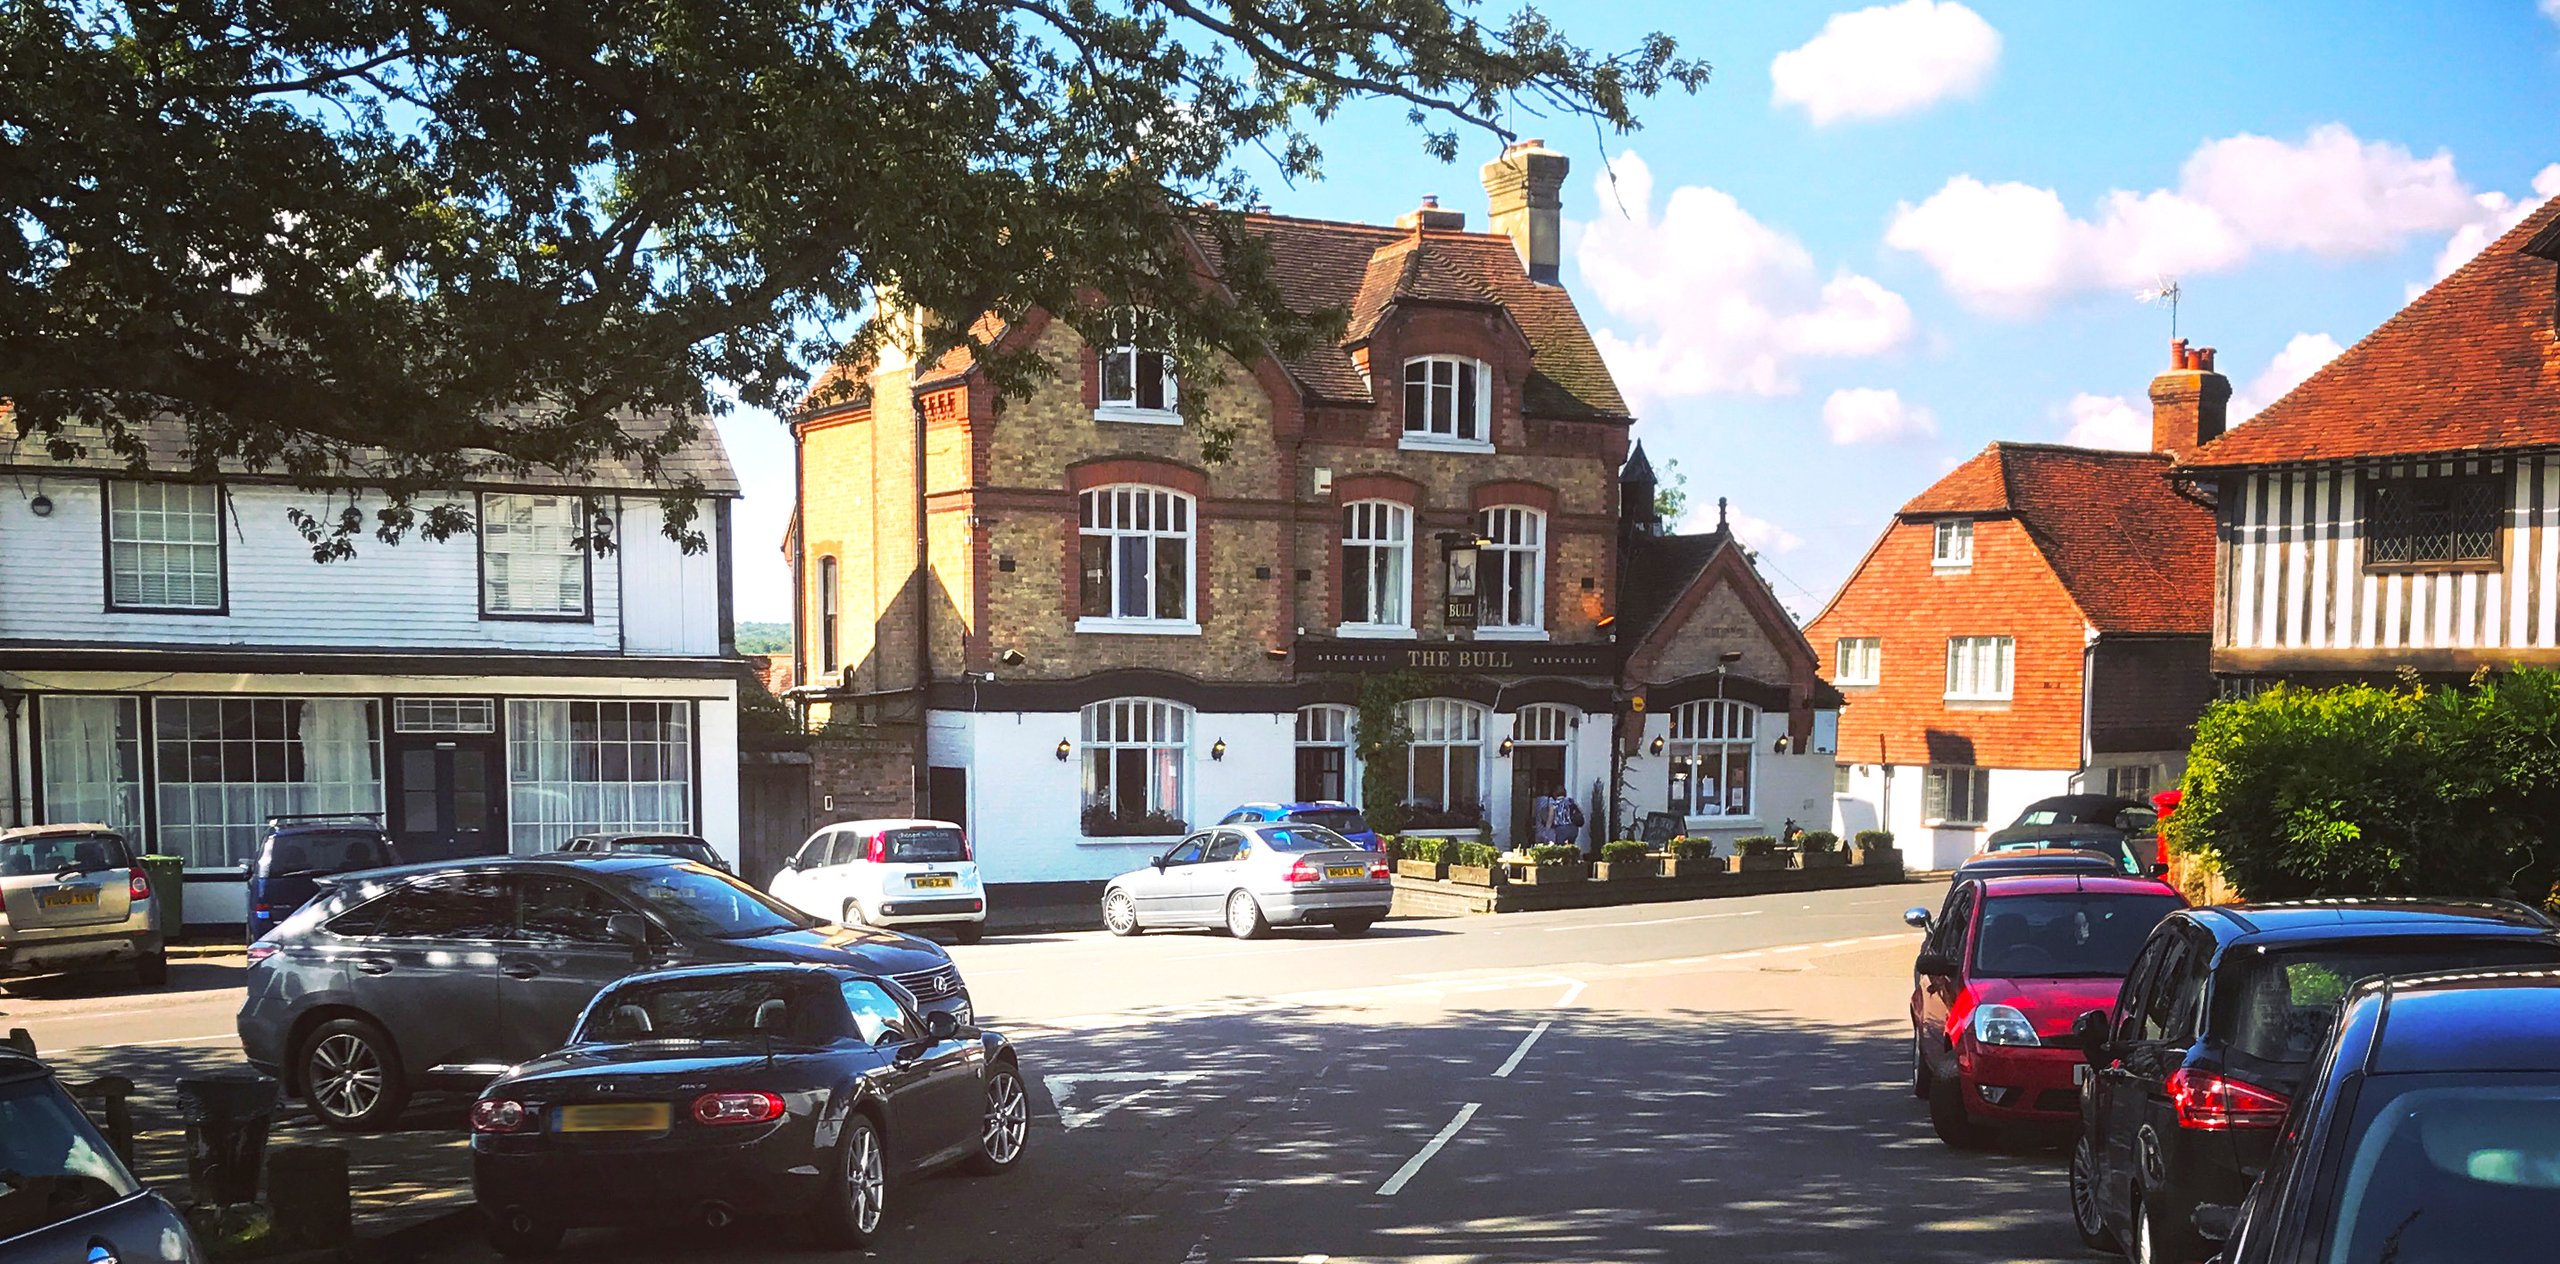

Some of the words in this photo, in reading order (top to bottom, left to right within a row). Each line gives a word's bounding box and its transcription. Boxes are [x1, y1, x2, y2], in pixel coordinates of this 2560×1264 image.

[1449, 603, 1474, 617] BULL
[1318, 654, 1386, 662] BRENCHLEY
[1407, 650, 1450, 667] THE
[1458, 651, 1513, 668] BULL
